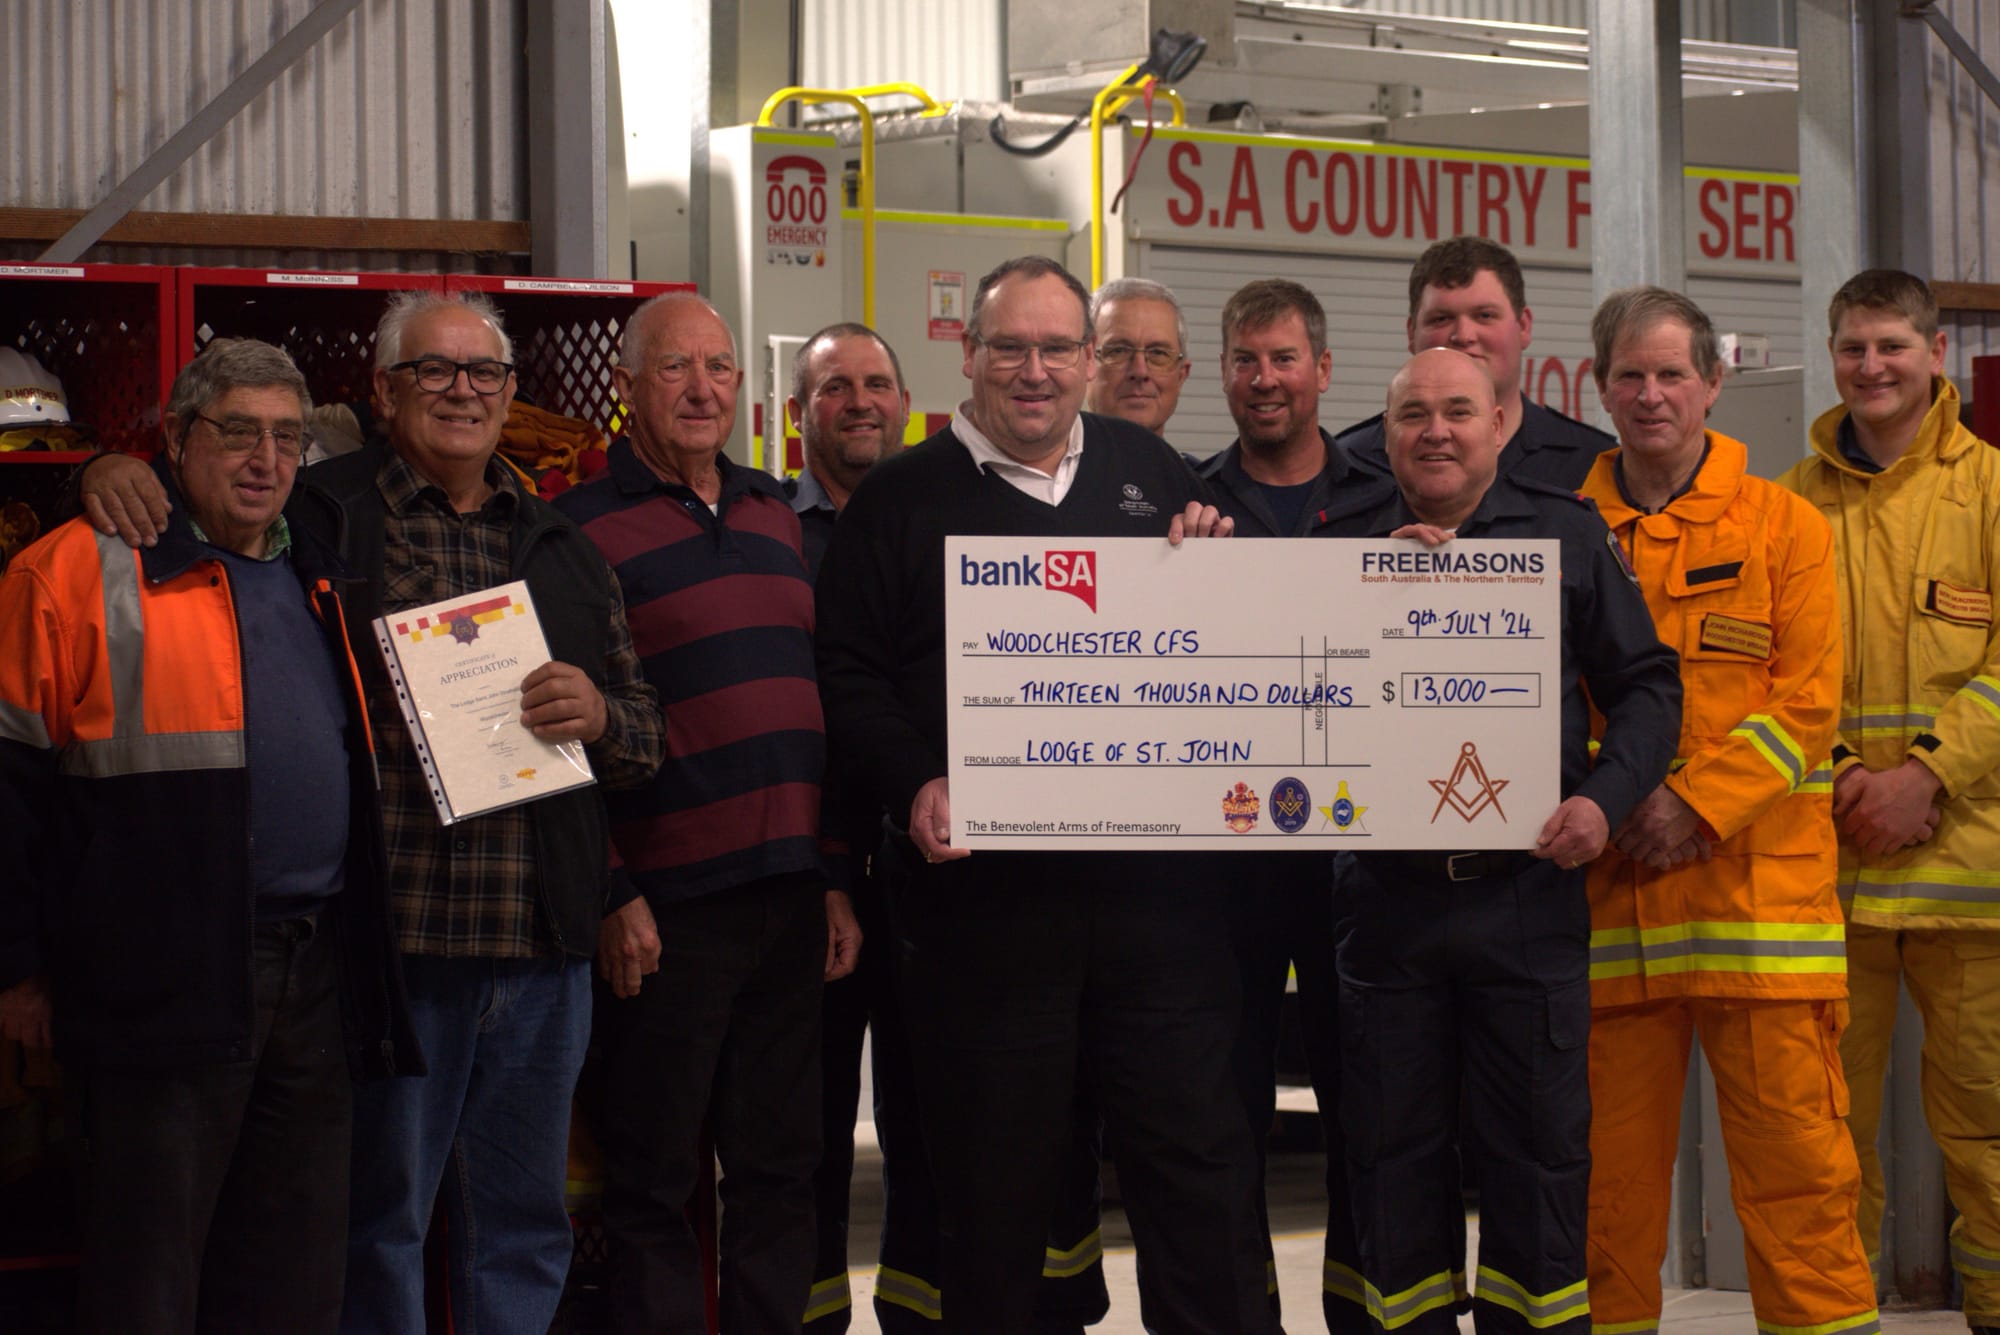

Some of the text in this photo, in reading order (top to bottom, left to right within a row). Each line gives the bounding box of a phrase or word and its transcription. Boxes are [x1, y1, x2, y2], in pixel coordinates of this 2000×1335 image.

[767, 183, 827, 224] 000
[1167, 140, 1799, 262] S.A COUNTRY F SER
[767, 225, 827, 246] EMERGENCY
[14, 267, 69, 275] MORTIMER
[1362, 552, 1545, 574] FREEMASONS
[1361, 574, 1545, 586] South Australia & The Northern Territory
[1382, 628, 1405, 637] DATE
[1442, 610, 1491, 636] JULY
[1500, 608, 1532, 639] '24
[962, 641, 979, 650] PAY
[986, 629, 1200, 656] WOODCHESTER CFS
[1327, 648, 1370, 656] OR BEARER
[440, 656, 518, 686] APPRECIATION
[963, 696, 1016, 705] THE SUM OF
[1020, 681, 1354, 707] THIRTEEN THOUSAND DOLLARS
[1382, 681, 1396, 704] $
[964, 756, 1022, 765] FROM LODGE
[1026, 739, 1252, 765] LODGE OF ST. JOHN
[966, 821, 1181, 834] The Benevolent Arms of Freemasonry
